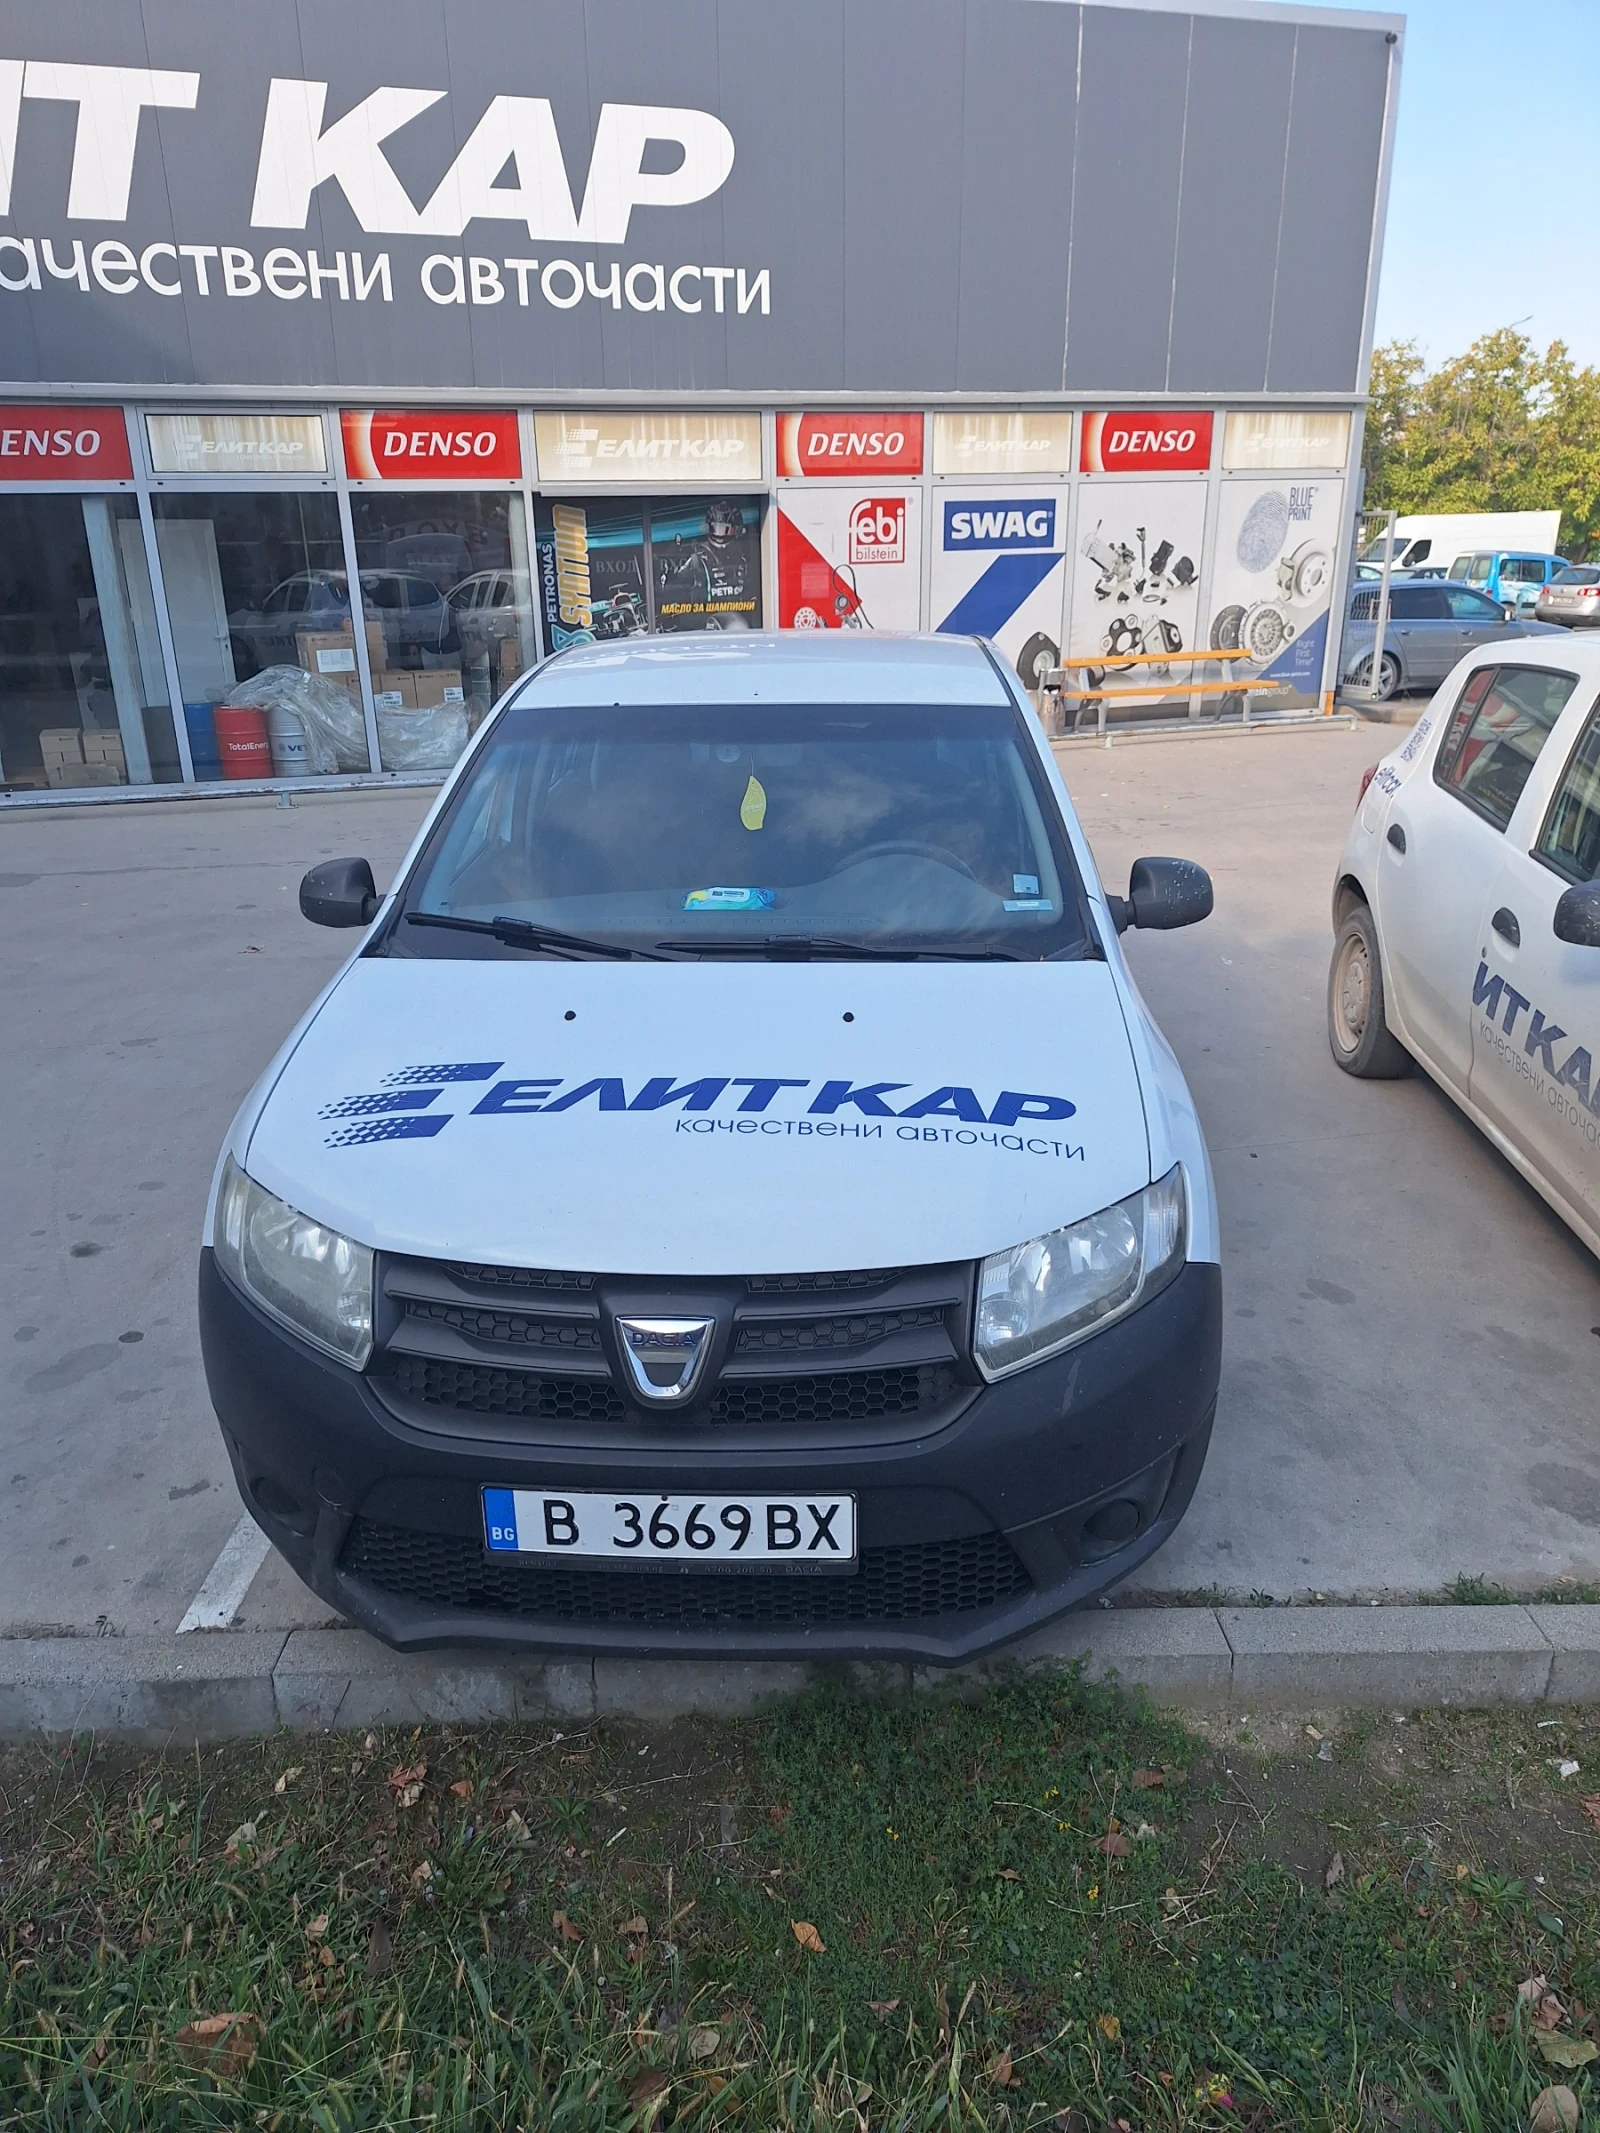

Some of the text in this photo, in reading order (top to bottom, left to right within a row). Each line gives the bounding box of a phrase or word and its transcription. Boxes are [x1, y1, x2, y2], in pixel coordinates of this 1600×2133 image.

[0, 60, 736, 244] Т КАР
[0, 236, 771, 315] ачествени авточасти
[0, 430, 100, 456] ENSO
[384, 431, 497, 457] DENSO
[807, 432, 905, 456] DENSO
[1108, 430, 1196, 453] DENSO
[1290, 486, 1315, 507] BLUE
[848, 500, 905, 545] febi
[951, 510, 1048, 540] SWAG
[1287, 507, 1312, 521] PRINT
[553, 504, 592, 627] SYNTIUM
[855, 547, 899, 561] bilstein
[541, 543, 558, 623] PETRONAS
[661, 601, 756, 615] МАСЛО ЗА ШАМПИОНИ
[1295, 649, 1311, 658] First
[1296, 640, 1315, 649] Right
[1480, 1021, 1546, 1097] качествени
[1524, 1008, 1600, 1119] КА
[675, 1119, 1086, 1163] качествени авточасти
[631, 1331, 697, 1347] DACIA
[491, 1526, 516, 1542] BG
